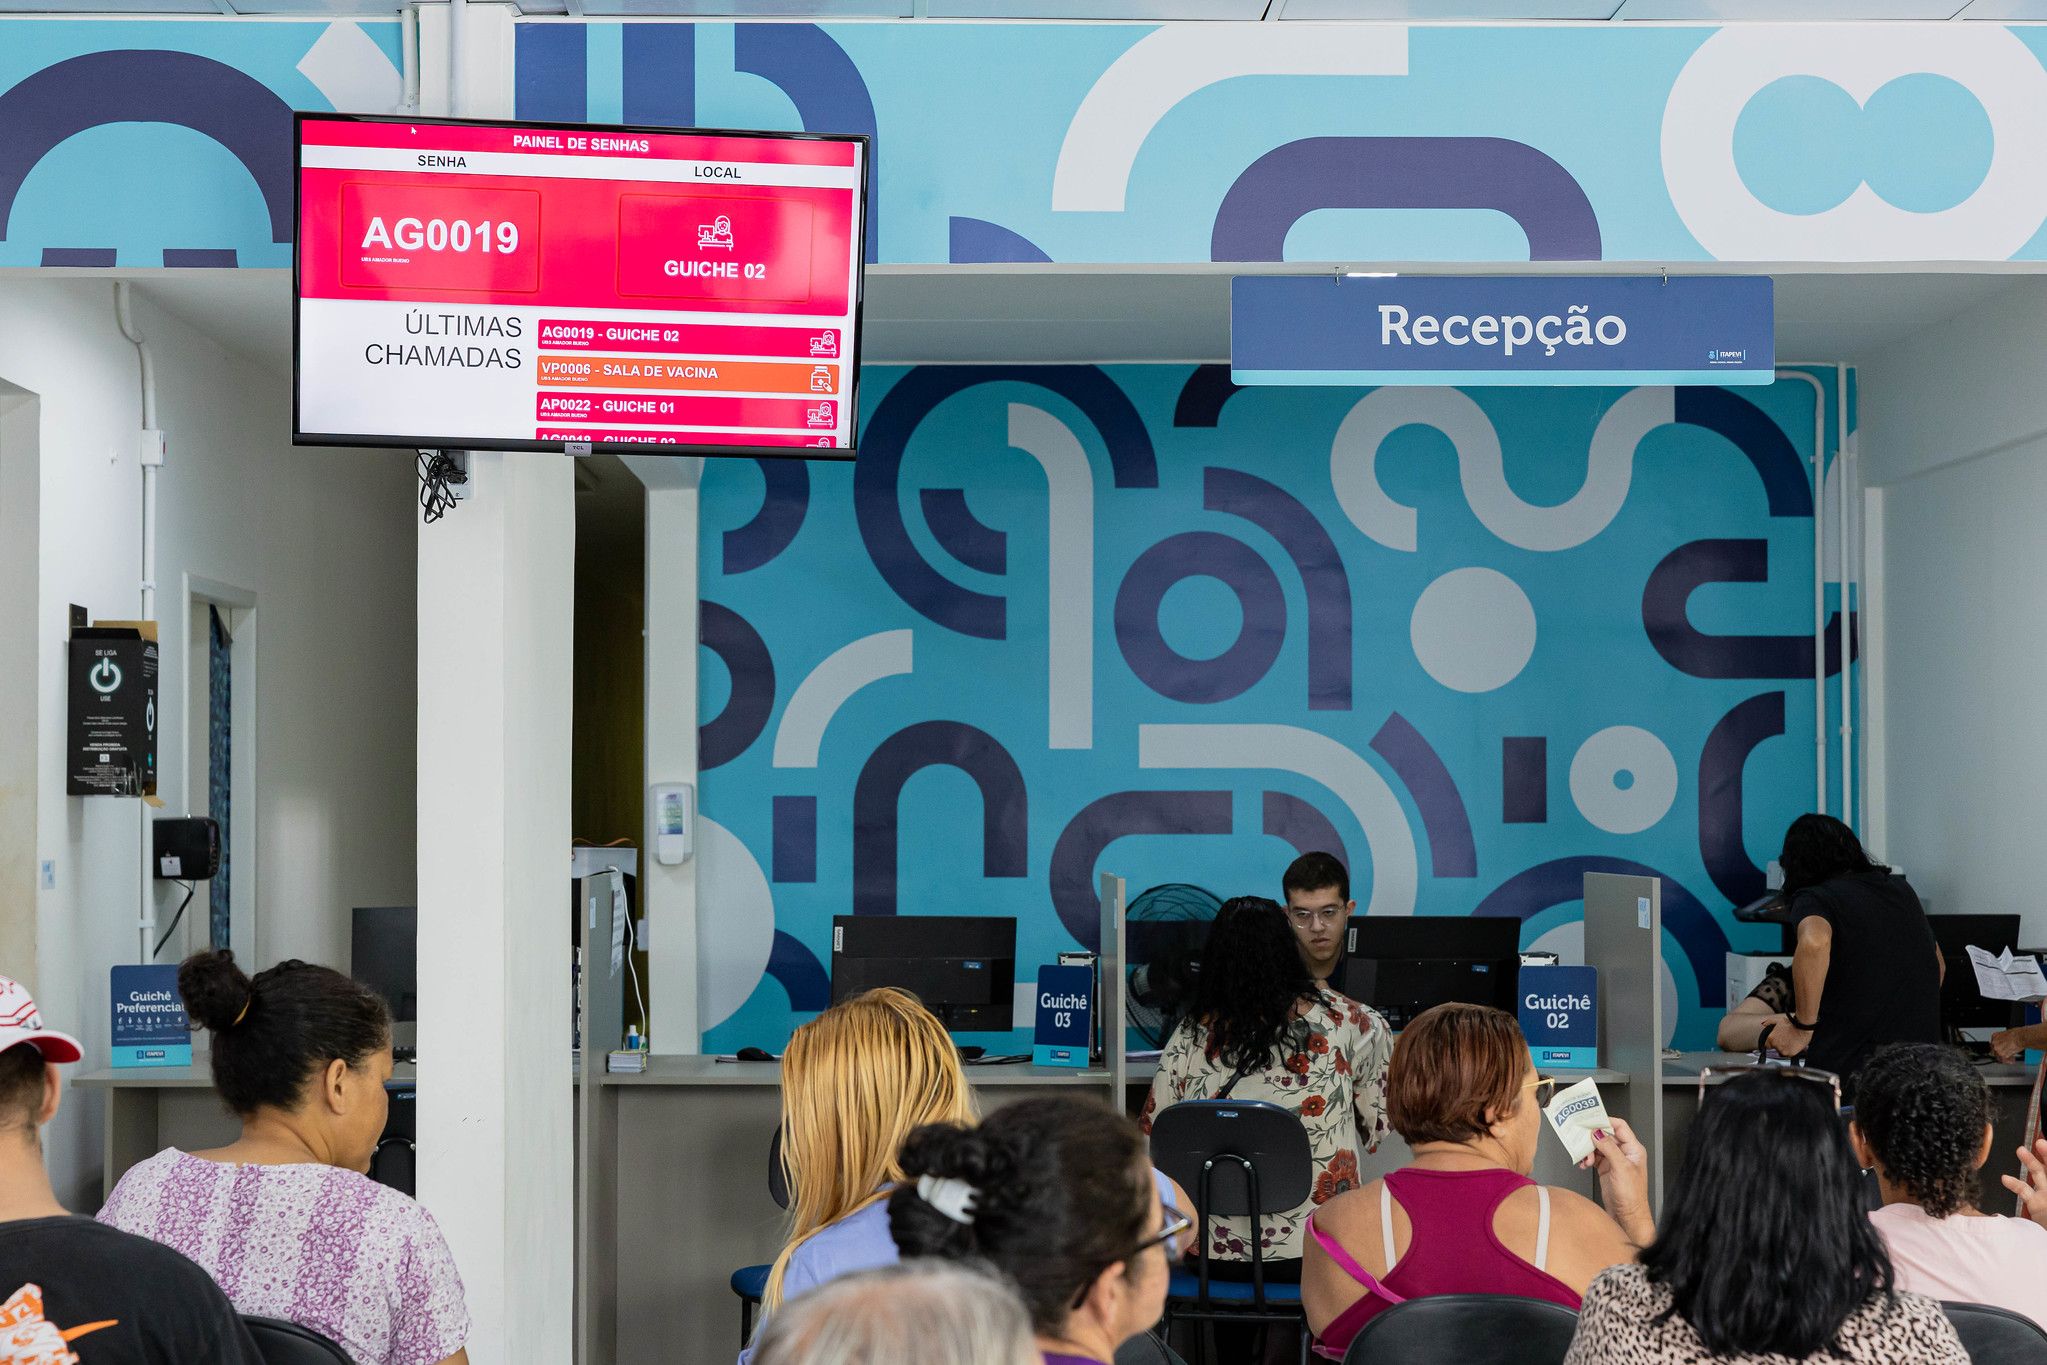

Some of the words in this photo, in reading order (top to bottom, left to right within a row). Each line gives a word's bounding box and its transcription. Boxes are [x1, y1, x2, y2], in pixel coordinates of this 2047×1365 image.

[513, 135, 564, 149] PAINEL
[567, 137, 587, 150] DE
[590, 138, 649, 153] SENHAS
[417, 154, 467, 168] SENHA
[694, 165, 742, 179] LOCAL
[361, 216, 519, 254] AG0019
[664, 260, 738, 278] GUICHE
[744, 263, 766, 279] 02
[405, 308, 522, 338] ÚLTIMAS
[1379, 304, 1627, 356] Recepção
[541, 326, 595, 339] AG0019
[606, 327, 660, 341] GUICHE
[663, 330, 680, 342] 02
[365, 343, 522, 369] CHAMADAS
[541, 362, 591, 375] VP0006
[603, 364, 641, 377] SALA
[644, 365, 662, 377] DE
[666, 366, 718, 379] VACINA
[540, 398, 591, 411] AP0022
[602, 400, 656, 413] GUICHE
[659, 402, 675, 414] 01
[130, 990, 172, 1002] Guichê
[1040, 992, 1087, 1010] Guichê
[1525, 993, 1591, 1010] Guichê
[1054, 1011, 1071, 1028] 03
[1546, 1012, 1569, 1029] 02
[1558, 1098, 1596, 1124] AG0039
